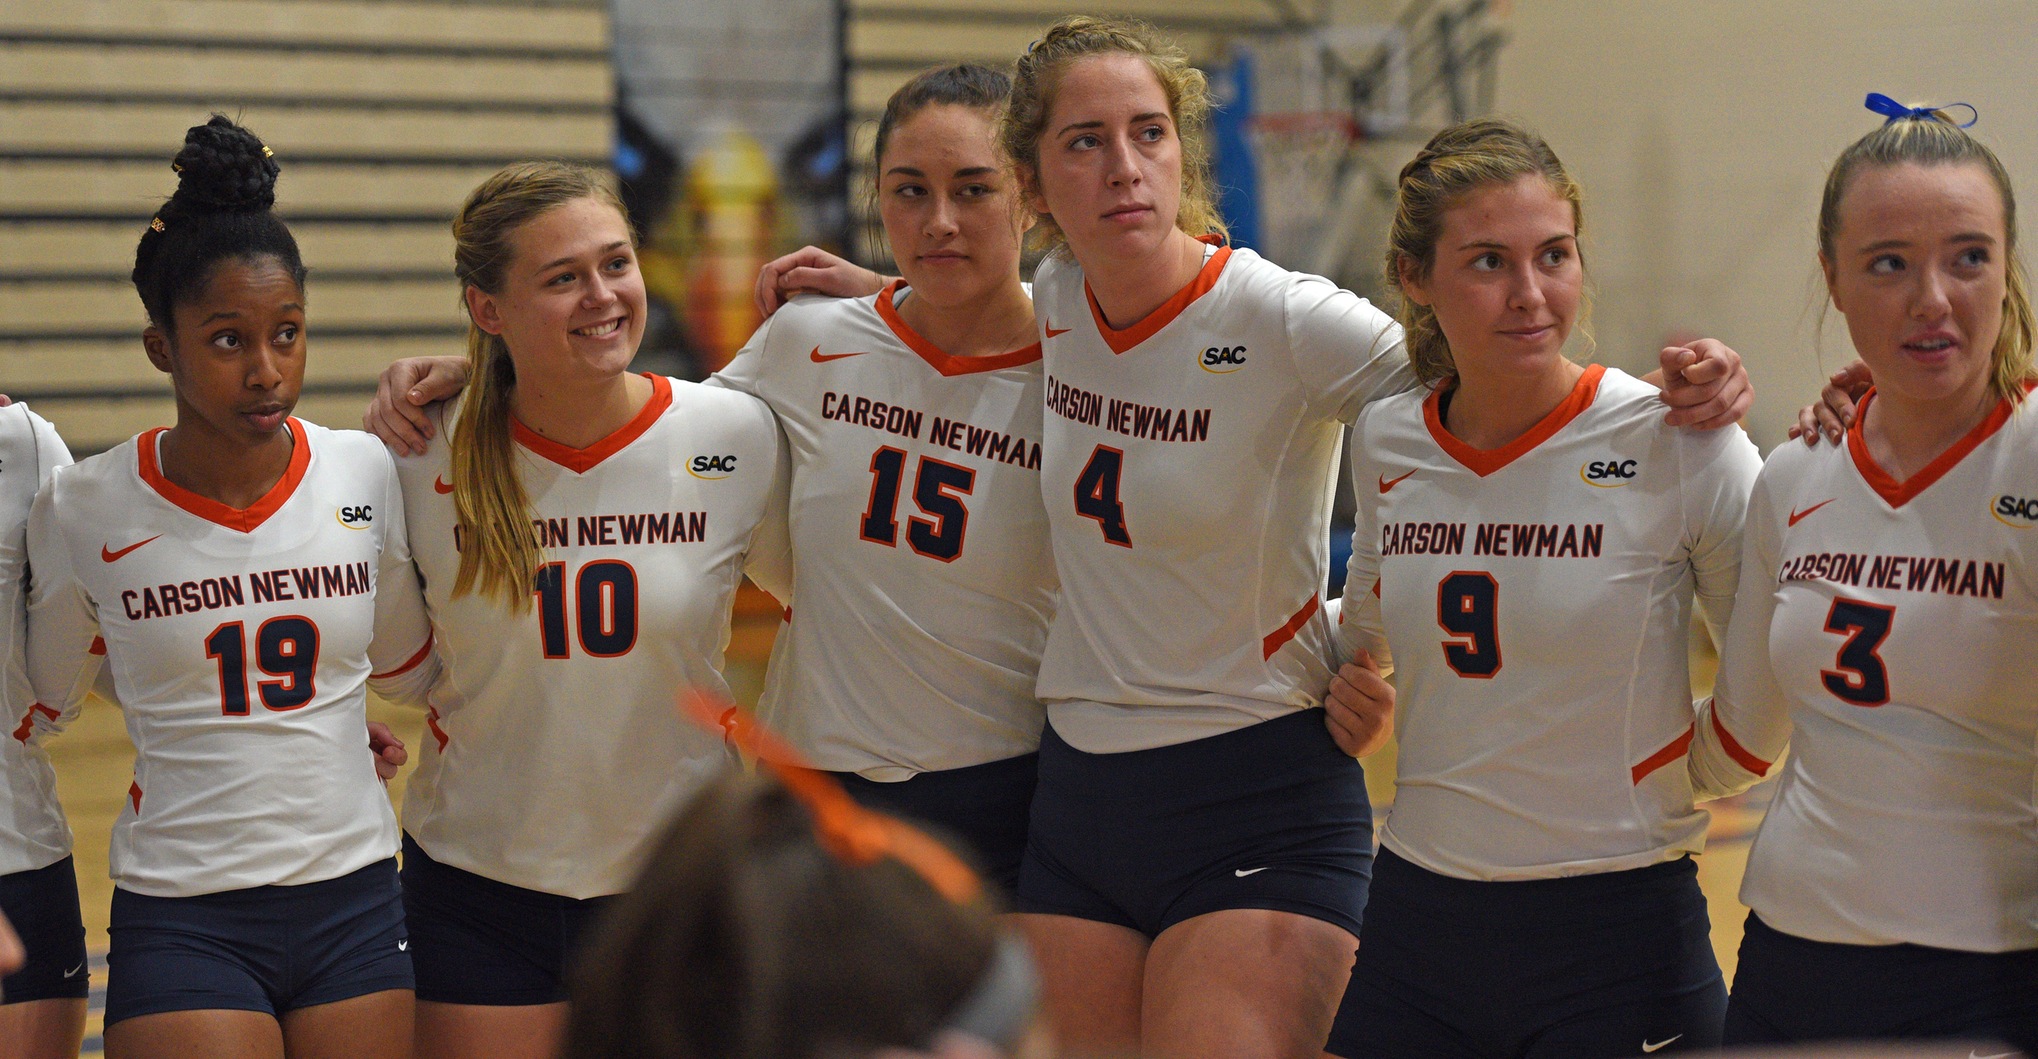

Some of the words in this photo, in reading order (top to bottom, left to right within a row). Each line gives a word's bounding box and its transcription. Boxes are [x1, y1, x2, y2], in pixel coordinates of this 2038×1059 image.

[1202, 345, 1247, 367] SAC
[821, 391, 924, 440] CARSON
[929, 416, 1042, 471] NEWMAN
[1046, 374, 1103, 427] CARSON
[1106, 398, 1211, 442] NEWMAN
[691, 455, 738, 473] SAC
[1586, 459, 1638, 480] SAC
[340, 504, 374, 523] SAC
[859, 444, 977, 564] 15
[1073, 443, 1133, 549] 4
[1996, 495, 2038, 520] SAC
[577, 511, 708, 547] NEWMAN
[1381, 522, 1467, 556] CARSON
[1473, 523, 1604, 558] NEWMAN
[121, 574, 245, 621] CARSON
[249, 561, 371, 604] NEWMAN
[1866, 554, 2005, 600] NEWMAN
[533, 558, 639, 660] 10
[1437, 570, 1503, 679] 9
[204, 614, 321, 716] 19
[1820, 596, 1897, 708] 3
